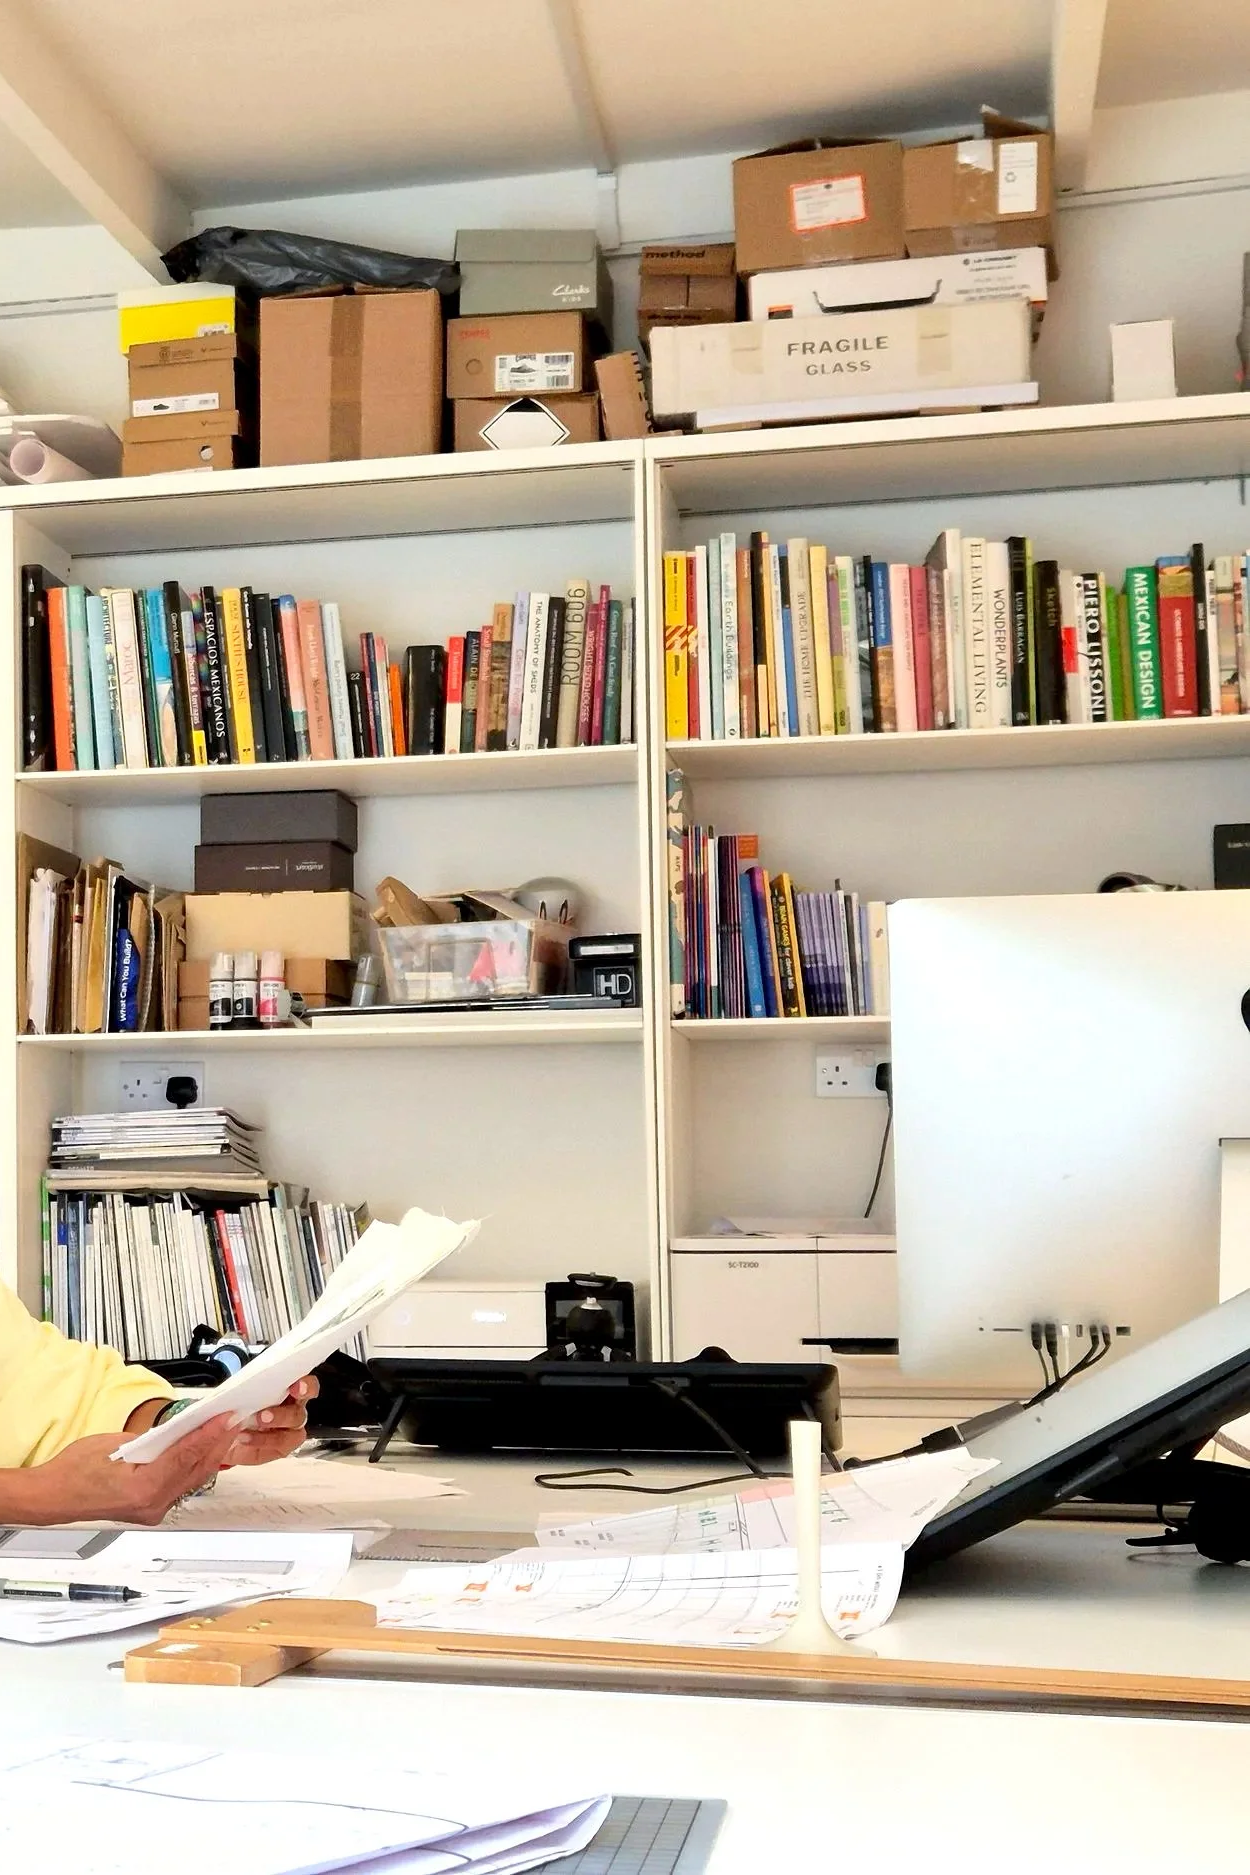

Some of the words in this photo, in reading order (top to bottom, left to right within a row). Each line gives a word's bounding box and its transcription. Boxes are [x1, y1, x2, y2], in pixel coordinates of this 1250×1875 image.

[645, 250, 706, 259] method
[552, 284, 591, 297] Clarks
[787, 335, 890, 357] FRAGILE
[806, 359, 872, 377] GLASS
[566, 585, 586, 623] 606
[970, 542, 985, 648] ELEMENTAL
[1015, 590, 1025, 611] LUIS
[1045, 586, 1056, 627] Sketch
[1083, 578, 1100, 634] PIERO
[1133, 572, 1152, 645] MEXICAN
[102, 594, 114, 646] ARCHITECTURE
[724, 600, 734, 632] Earth
[797, 590, 811, 641] UPGRADE
[204, 610, 219, 666] ESPACIOS
[481, 628, 494, 648] Small
[534, 617, 543, 654] ANATOMY
[992, 588, 1009, 689] WONDERPLANTS
[121, 643, 135, 685] Maroc
[470, 638, 480, 663] ALAIN
[532, 656, 540, 667] OF
[561, 629, 582, 687] ROOM
[723, 634, 735, 681] Buildings
[800, 643, 811, 675] HOME
[350, 672, 361, 681] 22
[470, 666, 479, 677] DE
[530, 670, 539, 694] SHEDS
[973, 653, 989, 713] LIVING
[1087, 641, 1106, 715] LISSONI
[1138, 649, 1157, 709] DESIGN
[235, 668, 247, 704] HOUSE
[802, 677, 814, 698] THE
[211, 668, 226, 738] MEXICANOS
[778, 904, 789, 924] BRAIN
[781, 923, 791, 946] GAMES
[123, 938, 133, 965] Build?
[121, 965, 131, 981] You
[785, 956, 794, 976] clever
[120, 981, 129, 998] Can
[597, 974, 632, 996] HD
[786, 975, 795, 989] kids
[119, 998, 128, 1022] What
